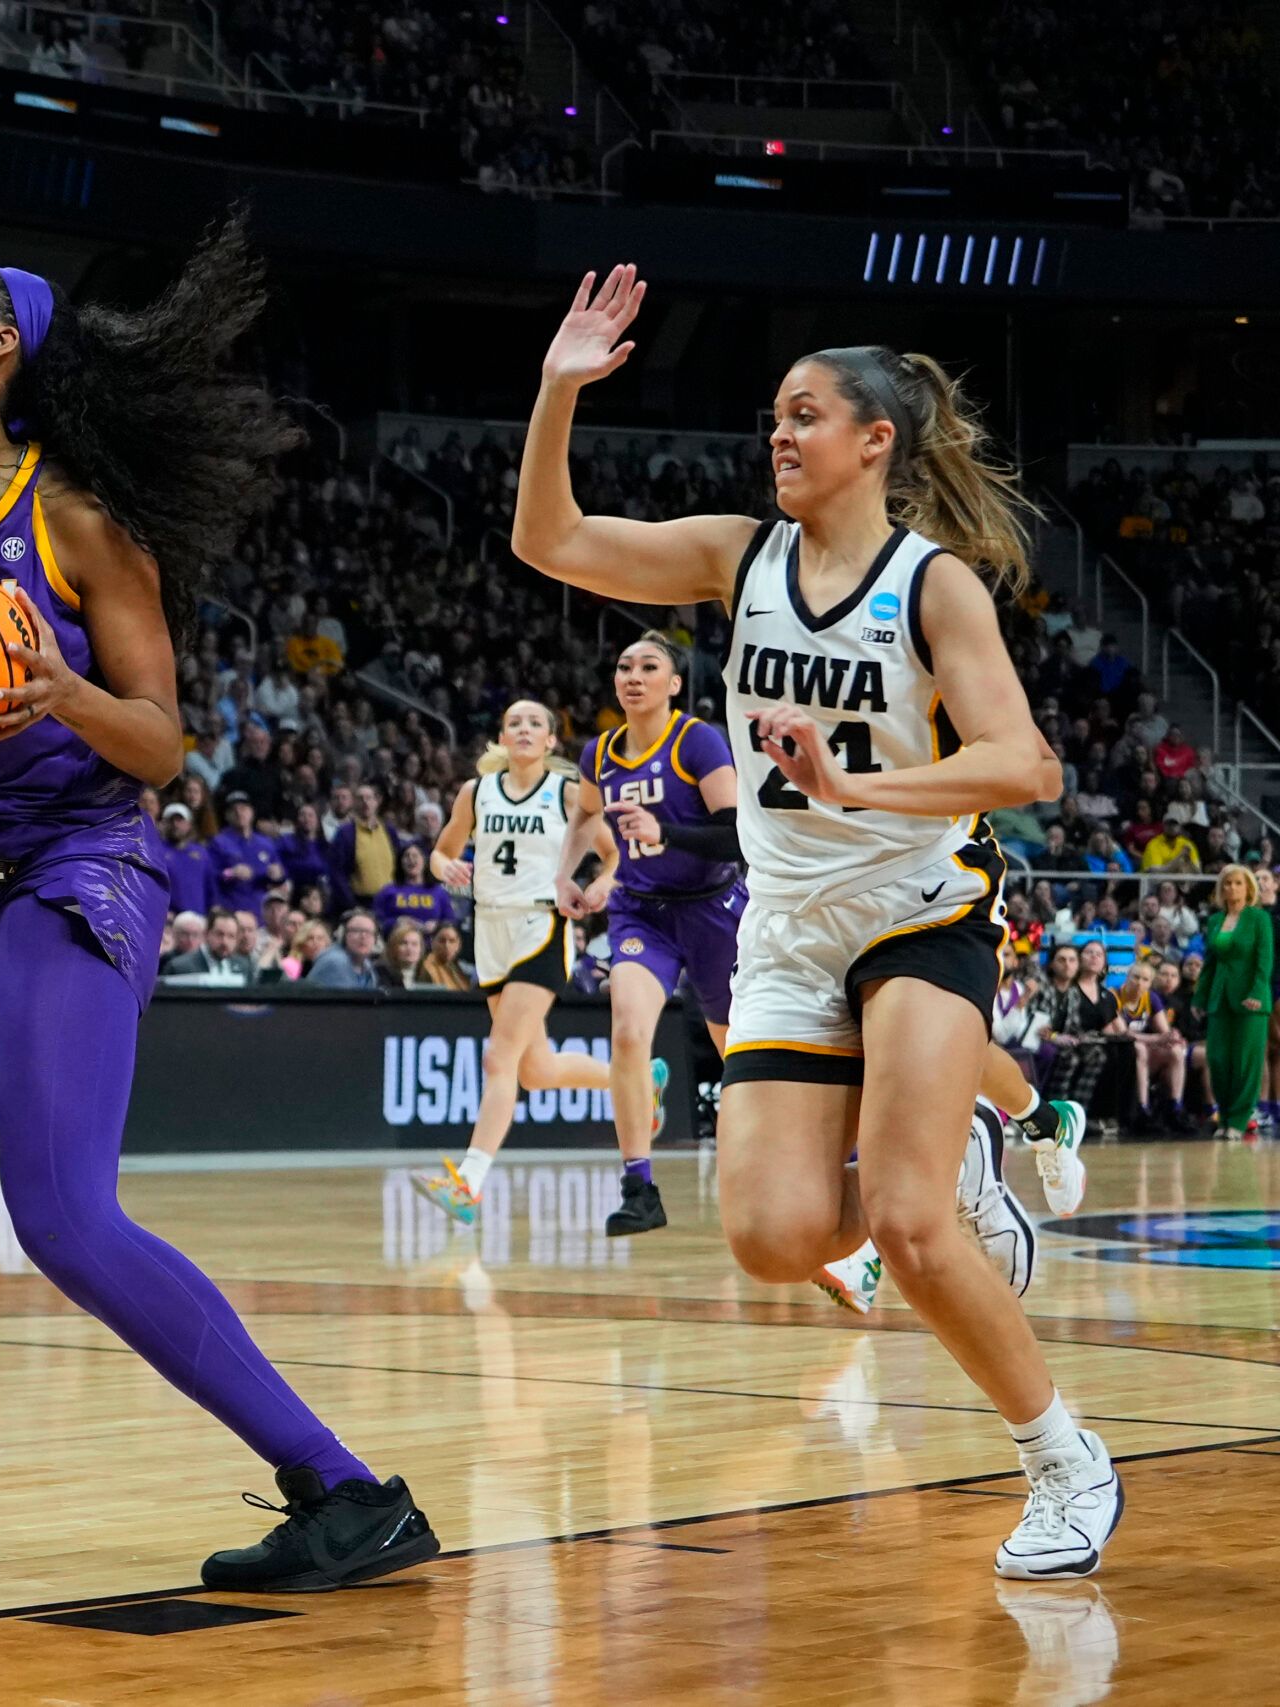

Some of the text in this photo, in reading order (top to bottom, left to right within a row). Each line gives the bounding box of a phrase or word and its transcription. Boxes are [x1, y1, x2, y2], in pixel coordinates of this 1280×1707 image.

[3, 539, 24, 559] SEC
[738, 643, 888, 712] IOWA
[604, 778, 664, 806] LSU
[483, 814, 545, 835] IOWA
[493, 840, 518, 875] 4
